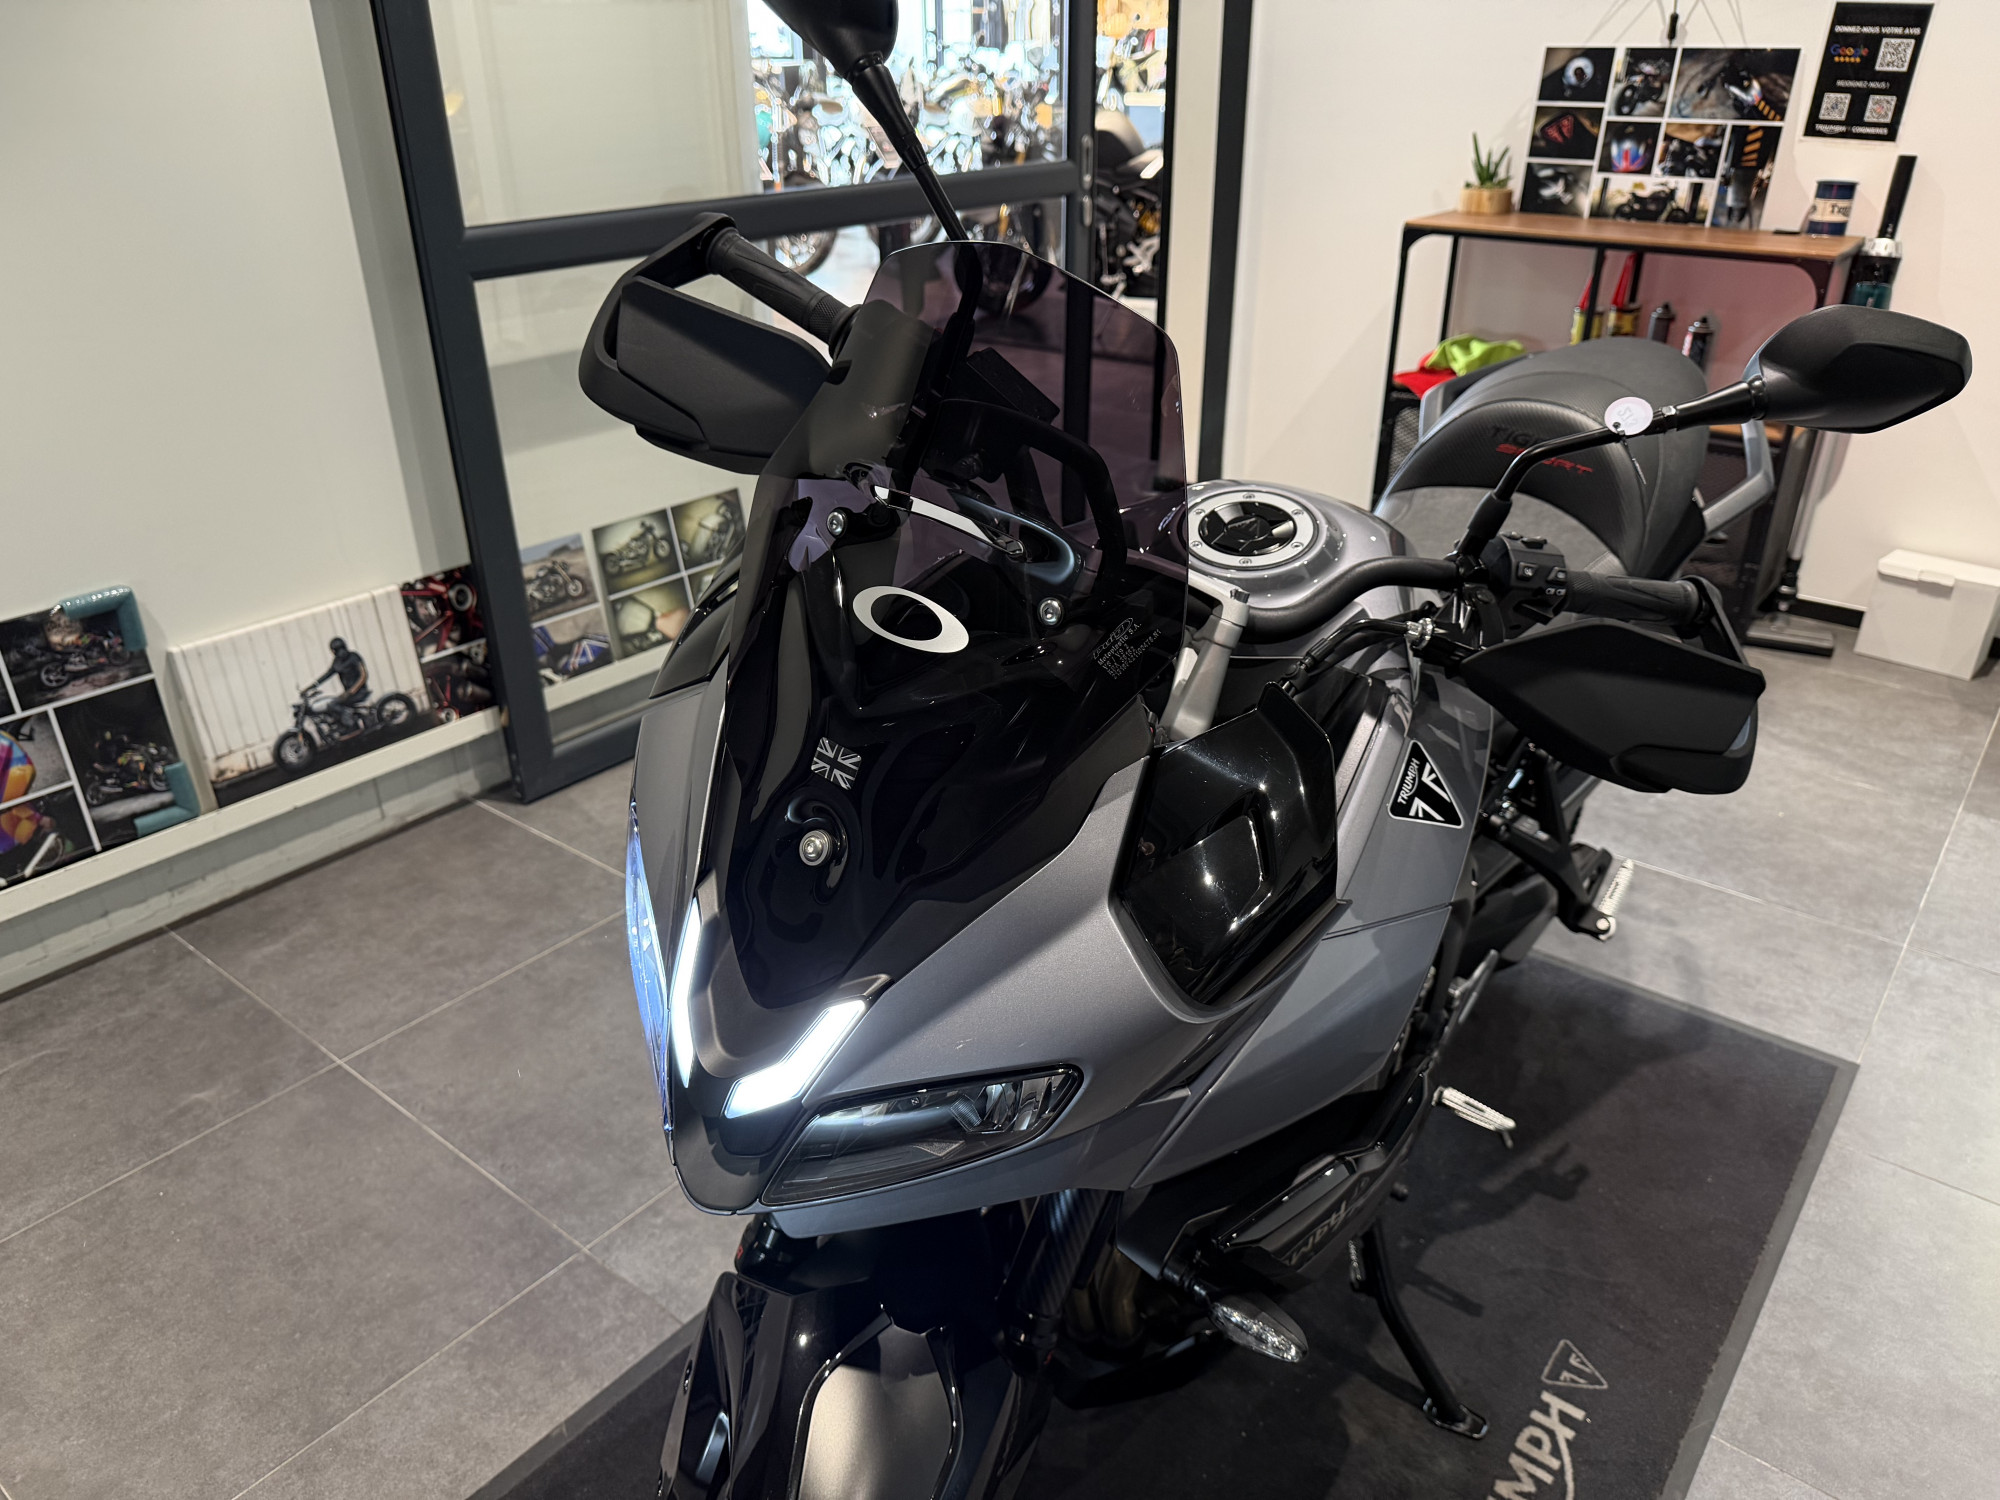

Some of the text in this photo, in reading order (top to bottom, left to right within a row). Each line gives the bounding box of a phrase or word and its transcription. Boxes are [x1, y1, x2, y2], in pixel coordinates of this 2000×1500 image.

[1834, 25, 1921, 35] DONNEZ-NOUS VOTRE AVIS
[1830, 44, 1869, 58] Google
[1397, 757, 1420, 805] TRIUMPH
[1486, 1390, 1587, 1500] MPH
